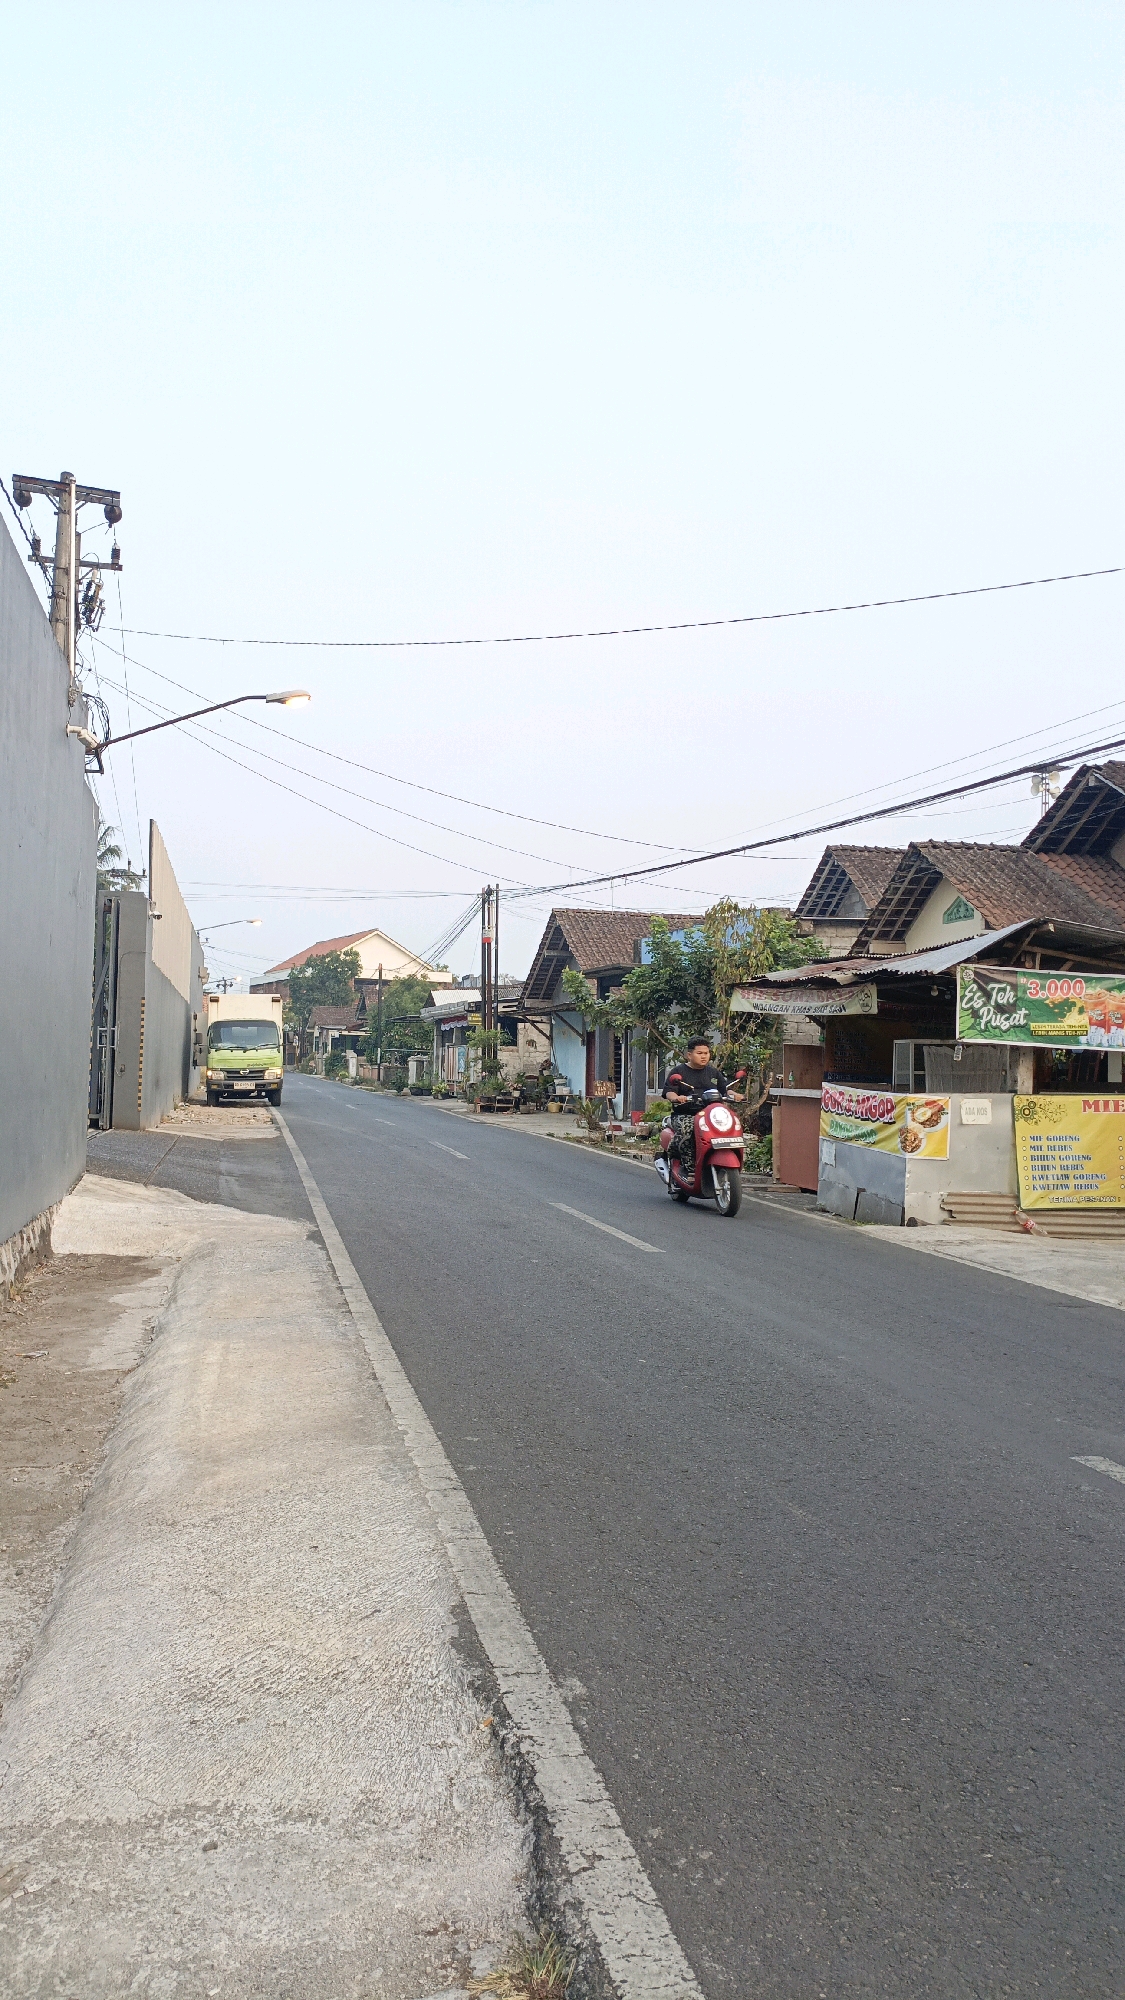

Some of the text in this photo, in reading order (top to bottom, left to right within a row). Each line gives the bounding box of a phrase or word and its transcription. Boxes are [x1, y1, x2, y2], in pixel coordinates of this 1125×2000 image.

[962, 983, 1016, 1009] Es Teh
[1027, 978, 1085, 998] 3.000
[979, 1006, 1029, 1031] Pusat
[821, 1086, 845, 1115] GOR
[1082, 1099, 1125, 1113] MIE
[964, 1106, 988, 1116] ADA KOS
[1073, 1173, 1106, 1181] GORENG
